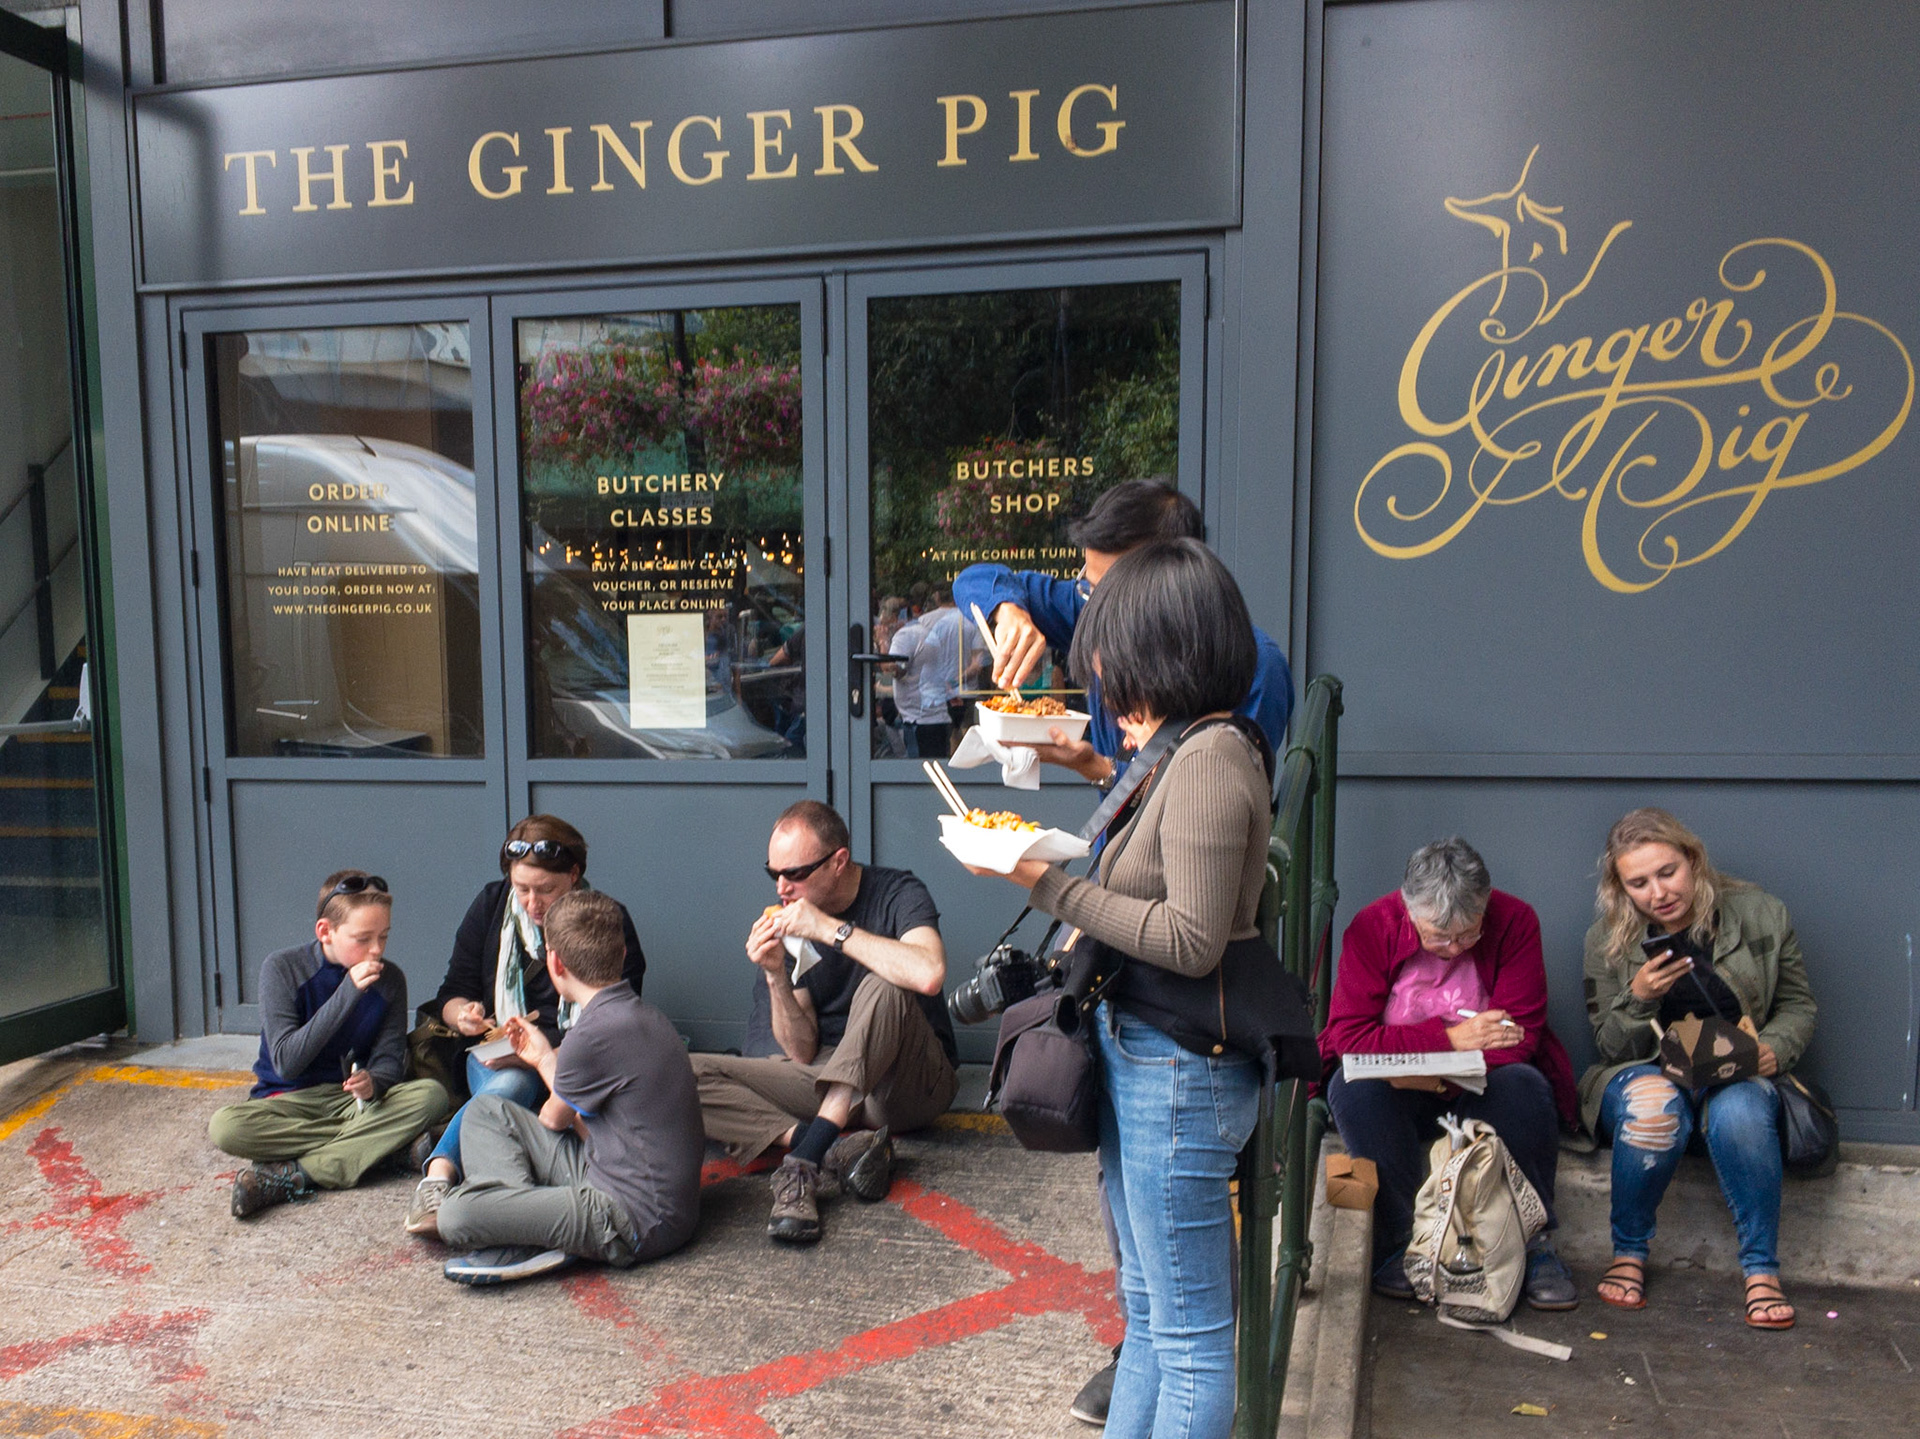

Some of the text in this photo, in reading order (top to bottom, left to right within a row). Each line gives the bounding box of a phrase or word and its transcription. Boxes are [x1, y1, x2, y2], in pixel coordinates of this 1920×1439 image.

[224, 84, 1126, 215] THE GINGER PIG
[956, 456, 1094, 481] BUTCHERS
[308, 482, 385, 501] ORDER
[597, 472, 724, 495] BUTCHERY
[990, 493, 1061, 514] SHOP
[307, 514, 390, 533] ONLINE
[610, 506, 713, 528] CLASSES
[932, 551, 947, 562] AT
[952, 550, 977, 561] THE
[981, 548, 1035, 561] CORNER
[1040, 547, 1077, 559] TURN
[278, 565, 427, 577] HAVE MEAT DELIVERED TO
[591, 561, 616, 573] BUY
[619, 561, 628, 572] A
[699, 558, 737, 570] CLASS
[267, 585, 299, 596] YOUR
[303, 585, 341, 597] DOOR,
[344, 584, 383, 595] ORDER
[386, 584, 414, 594] NOW
[592, 578, 734, 592] VOUCHER, OR RESERVE
[273, 603, 432, 615] WWW.THEGINGERPIG.CO.UK
[601, 598, 726, 611] YOUR PLACE ONLINE
